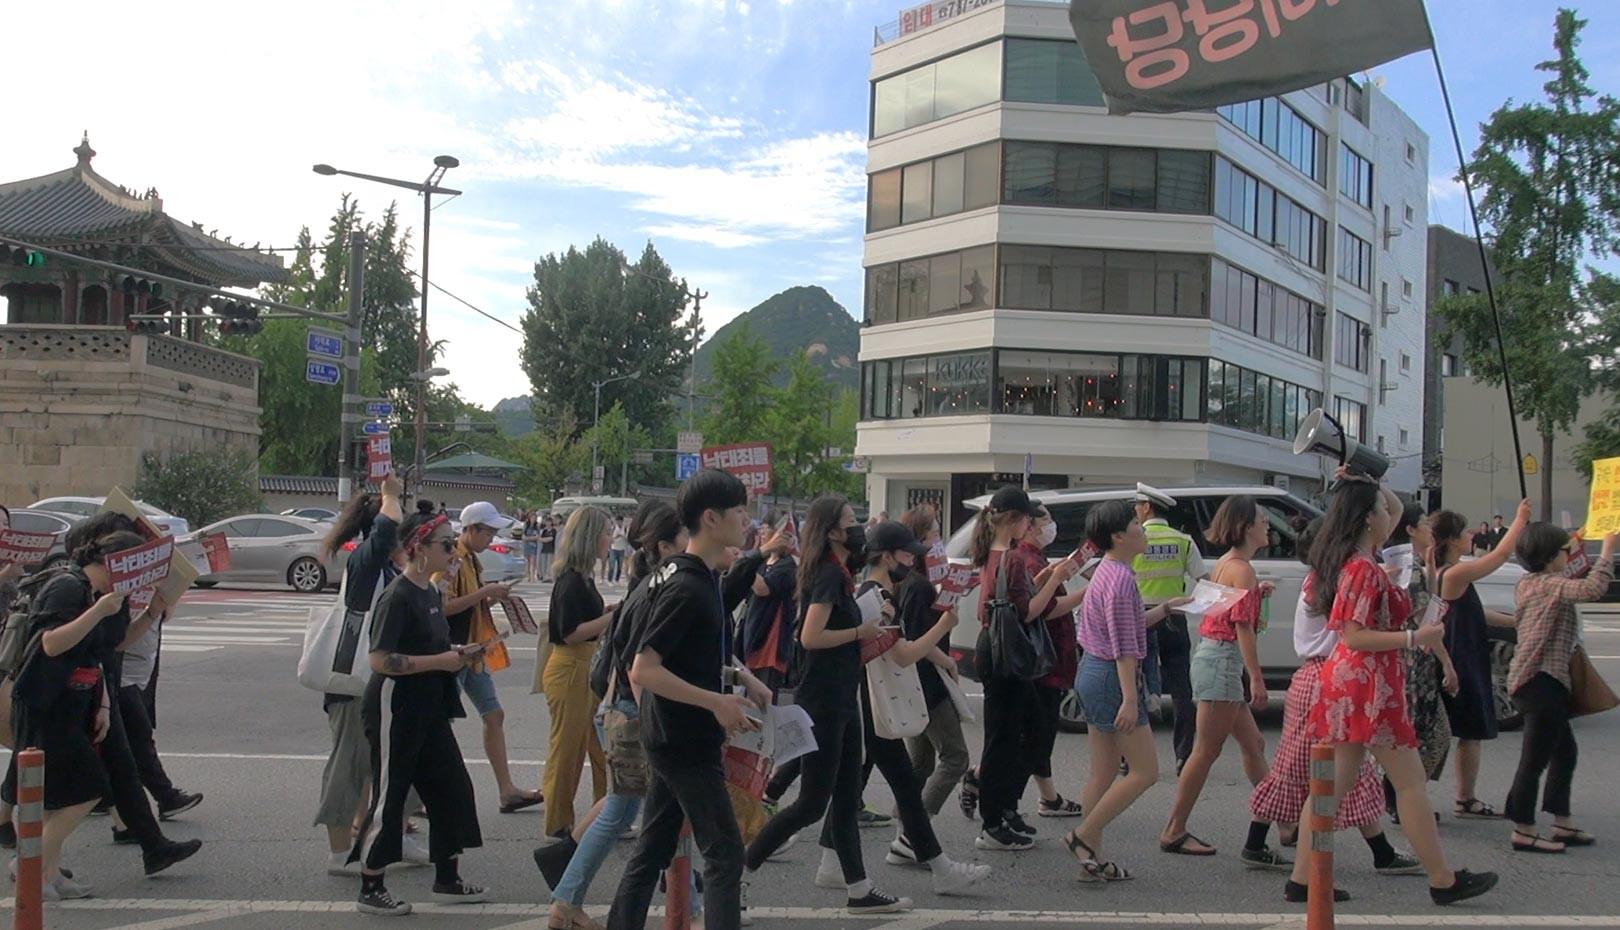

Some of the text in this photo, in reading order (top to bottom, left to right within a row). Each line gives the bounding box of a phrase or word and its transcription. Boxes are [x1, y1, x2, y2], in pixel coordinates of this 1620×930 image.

[902, 3, 932, 33] 임대
[703, 446, 768, 469] 낙태죄를
[110, 542, 172, 573] 낙태죄를
